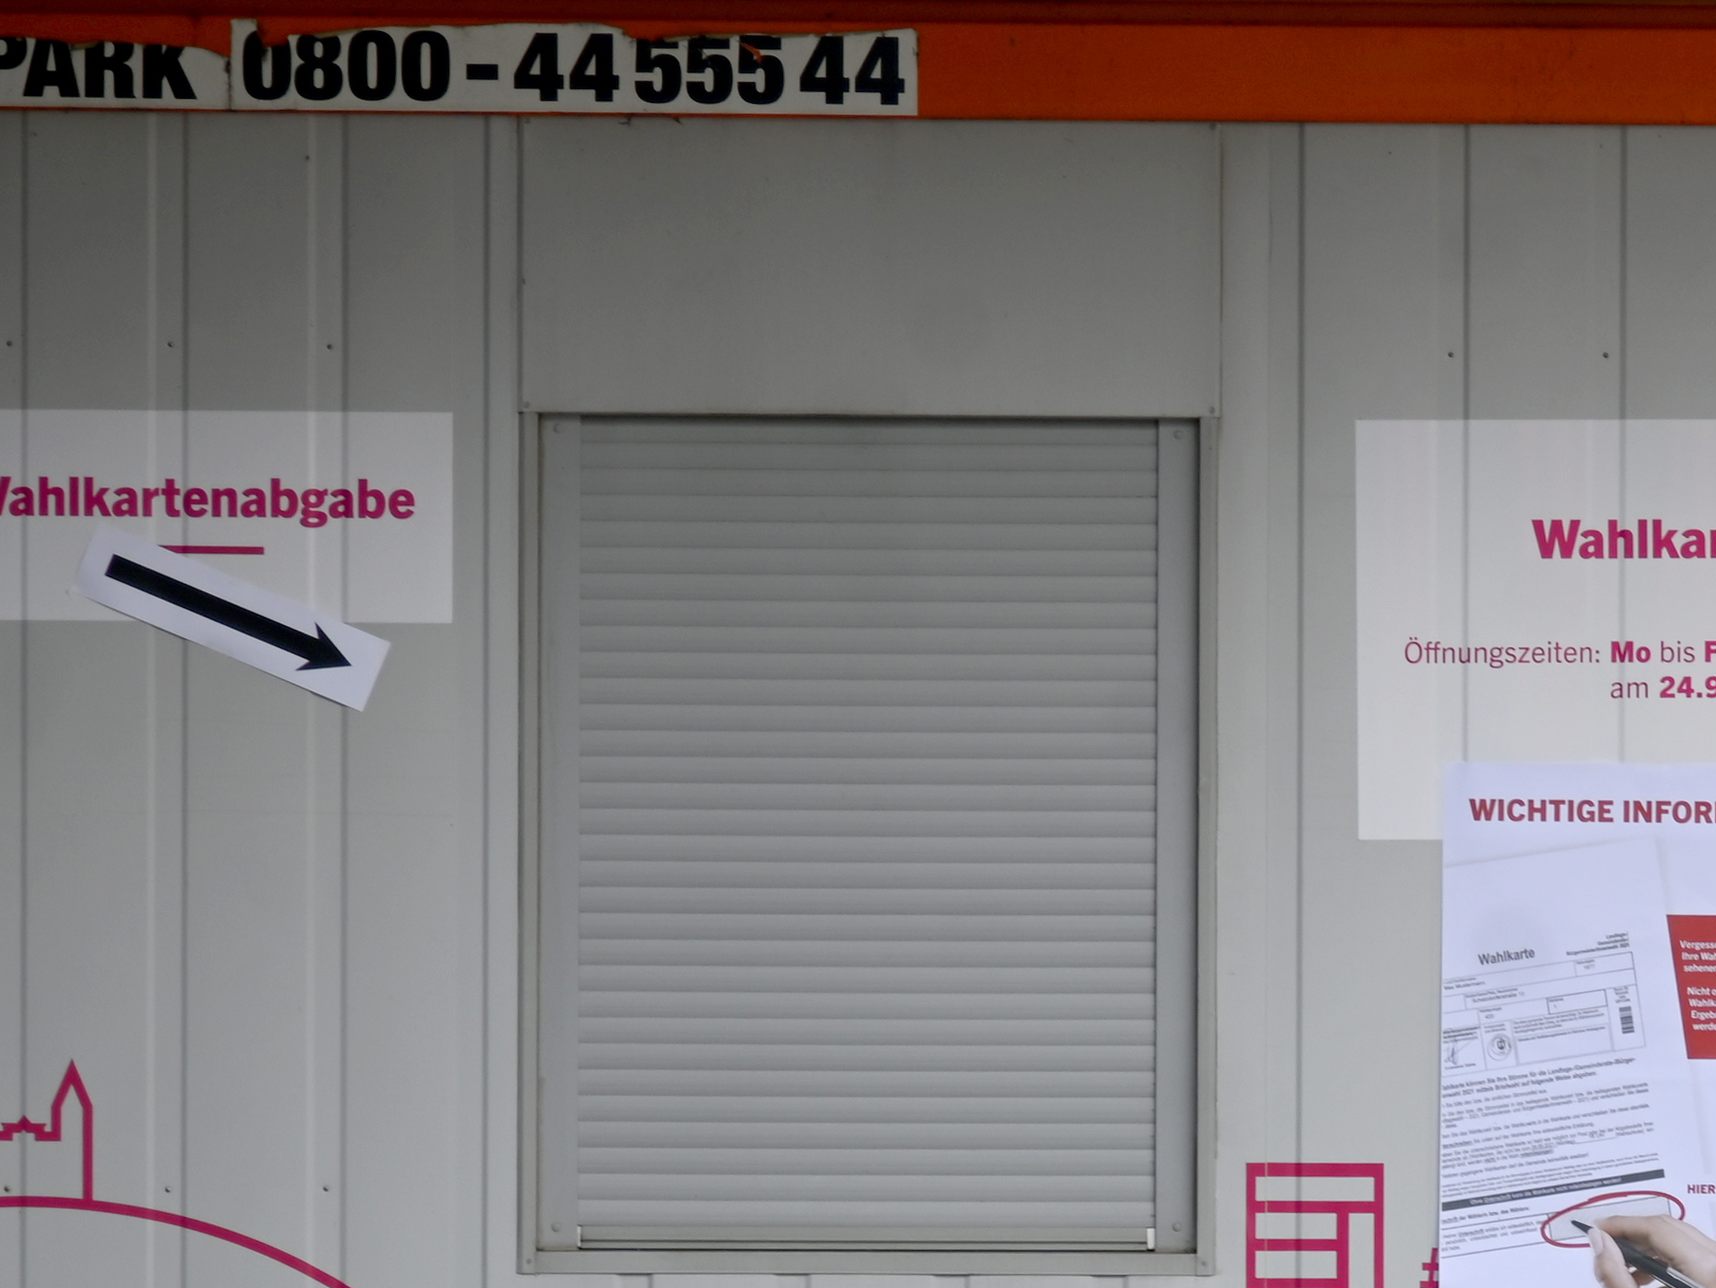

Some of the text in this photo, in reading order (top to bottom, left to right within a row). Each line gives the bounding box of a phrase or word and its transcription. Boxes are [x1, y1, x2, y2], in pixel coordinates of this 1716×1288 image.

[0, 476, 415, 528] ahlkartenabgabe
[1404, 637, 1600, 668] Öffnungszeiten:
[1611, 640, 1651, 663] Mo
[1660, 640, 1696, 663] bis
[1611, 681, 1649, 699] am
[1469, 798, 1615, 824] WICHTIGE
[1478, 948, 1536, 966] Wahlkarte
[1687, 987, 1710, 995] Nicht
[1687, 1184, 1716, 1194] HIER
